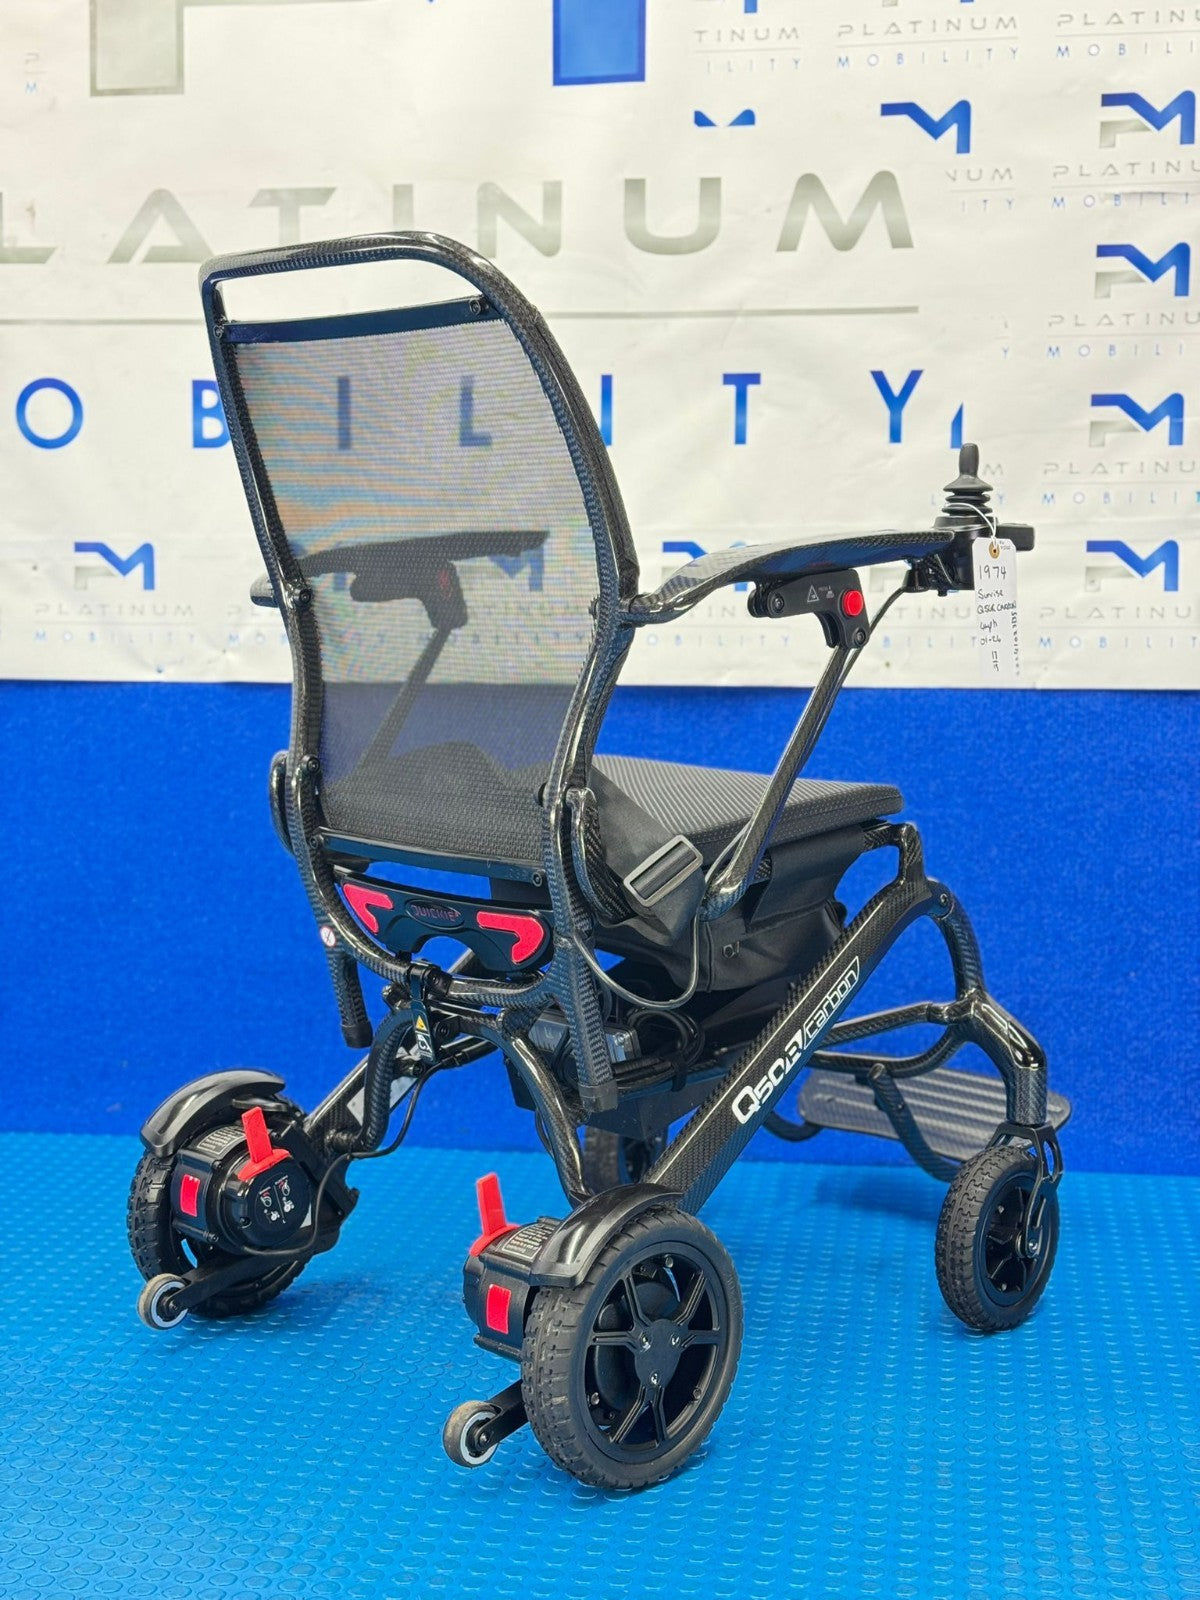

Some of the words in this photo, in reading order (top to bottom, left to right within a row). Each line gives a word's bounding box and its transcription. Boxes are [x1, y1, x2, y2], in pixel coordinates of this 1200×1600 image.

[837, 16, 1017, 37] PLATINUM
[837, 48, 1019, 68] MOBILITY
[979, 564, 1007, 580] 1974
[977, 588, 1004, 600] Sunrise
[731, 1028, 803, 1125] Q50R
[804, 968, 859, 1040] carbon
